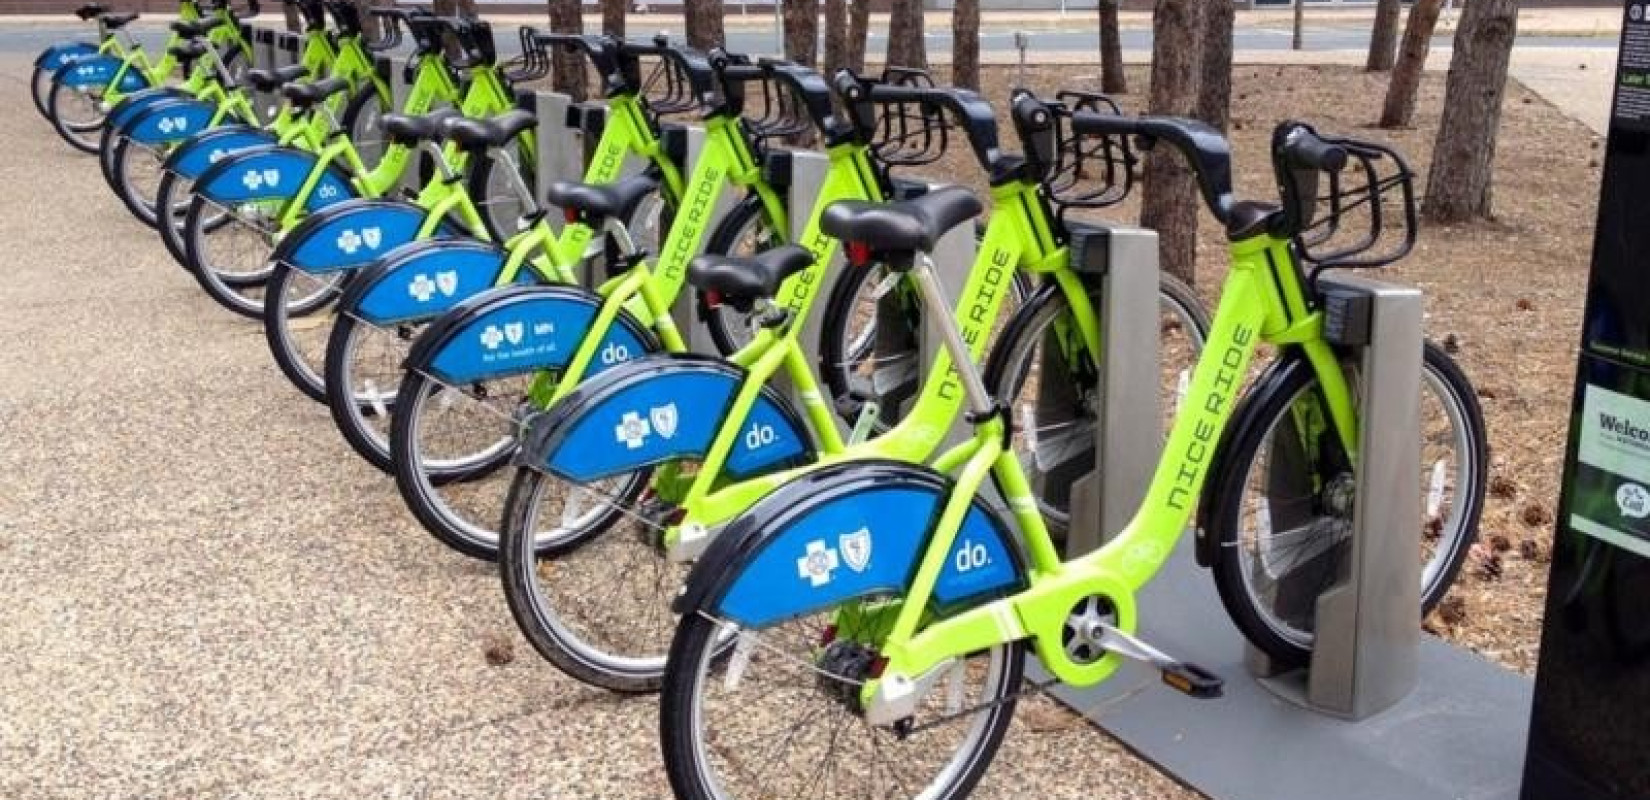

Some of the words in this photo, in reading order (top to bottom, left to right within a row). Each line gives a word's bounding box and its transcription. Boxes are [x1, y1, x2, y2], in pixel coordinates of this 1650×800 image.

[969, 248, 1010, 324] RIDE
[745, 422, 780, 450] do.
[1166, 419, 1215, 510] NICE
[1203, 323, 1252, 416] RIDE
[955, 539, 993, 573] do.
